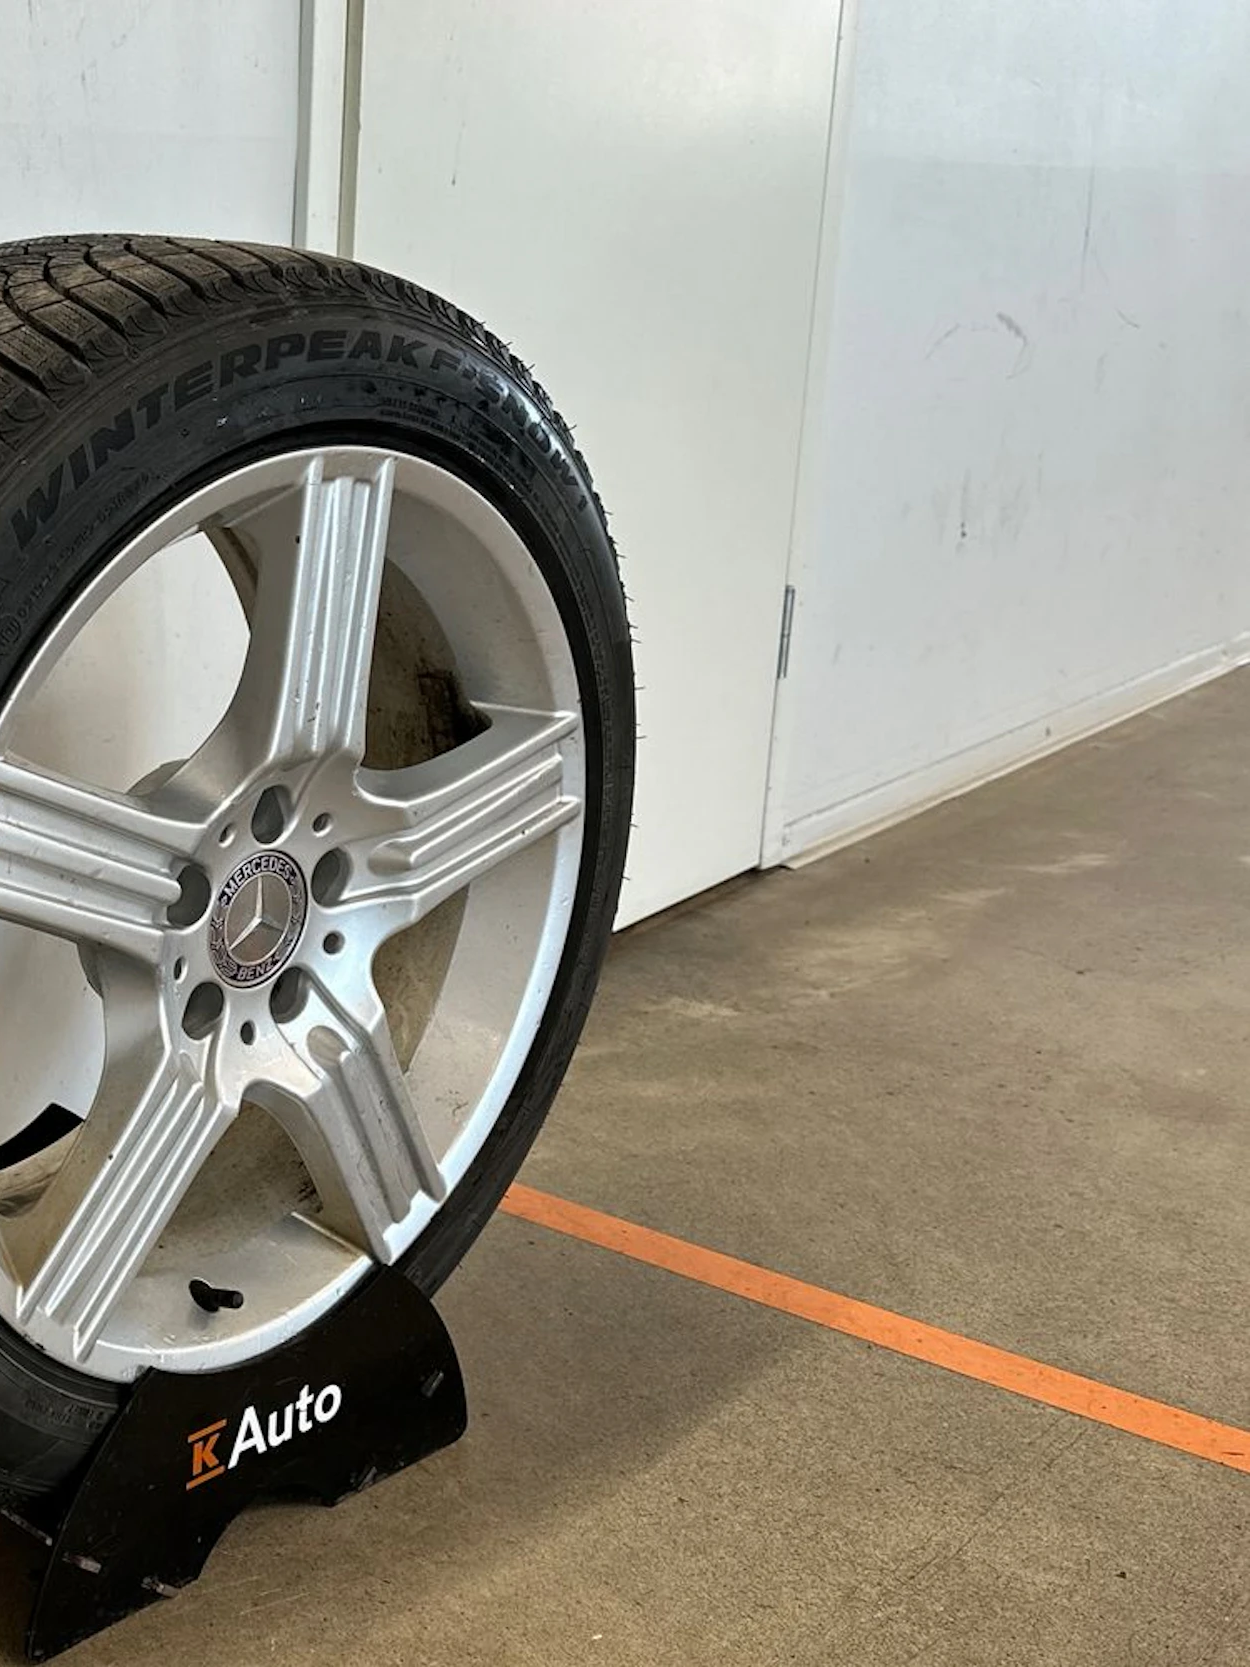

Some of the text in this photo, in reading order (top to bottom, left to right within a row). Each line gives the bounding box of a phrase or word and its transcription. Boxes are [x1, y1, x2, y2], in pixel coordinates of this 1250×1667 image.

[9, 329, 428, 551] WINTERPEAK
[224, 856, 293, 897] MERCEDES
[237, 958, 275, 981] BENZ
[227, 1384, 342, 1469] Auto
